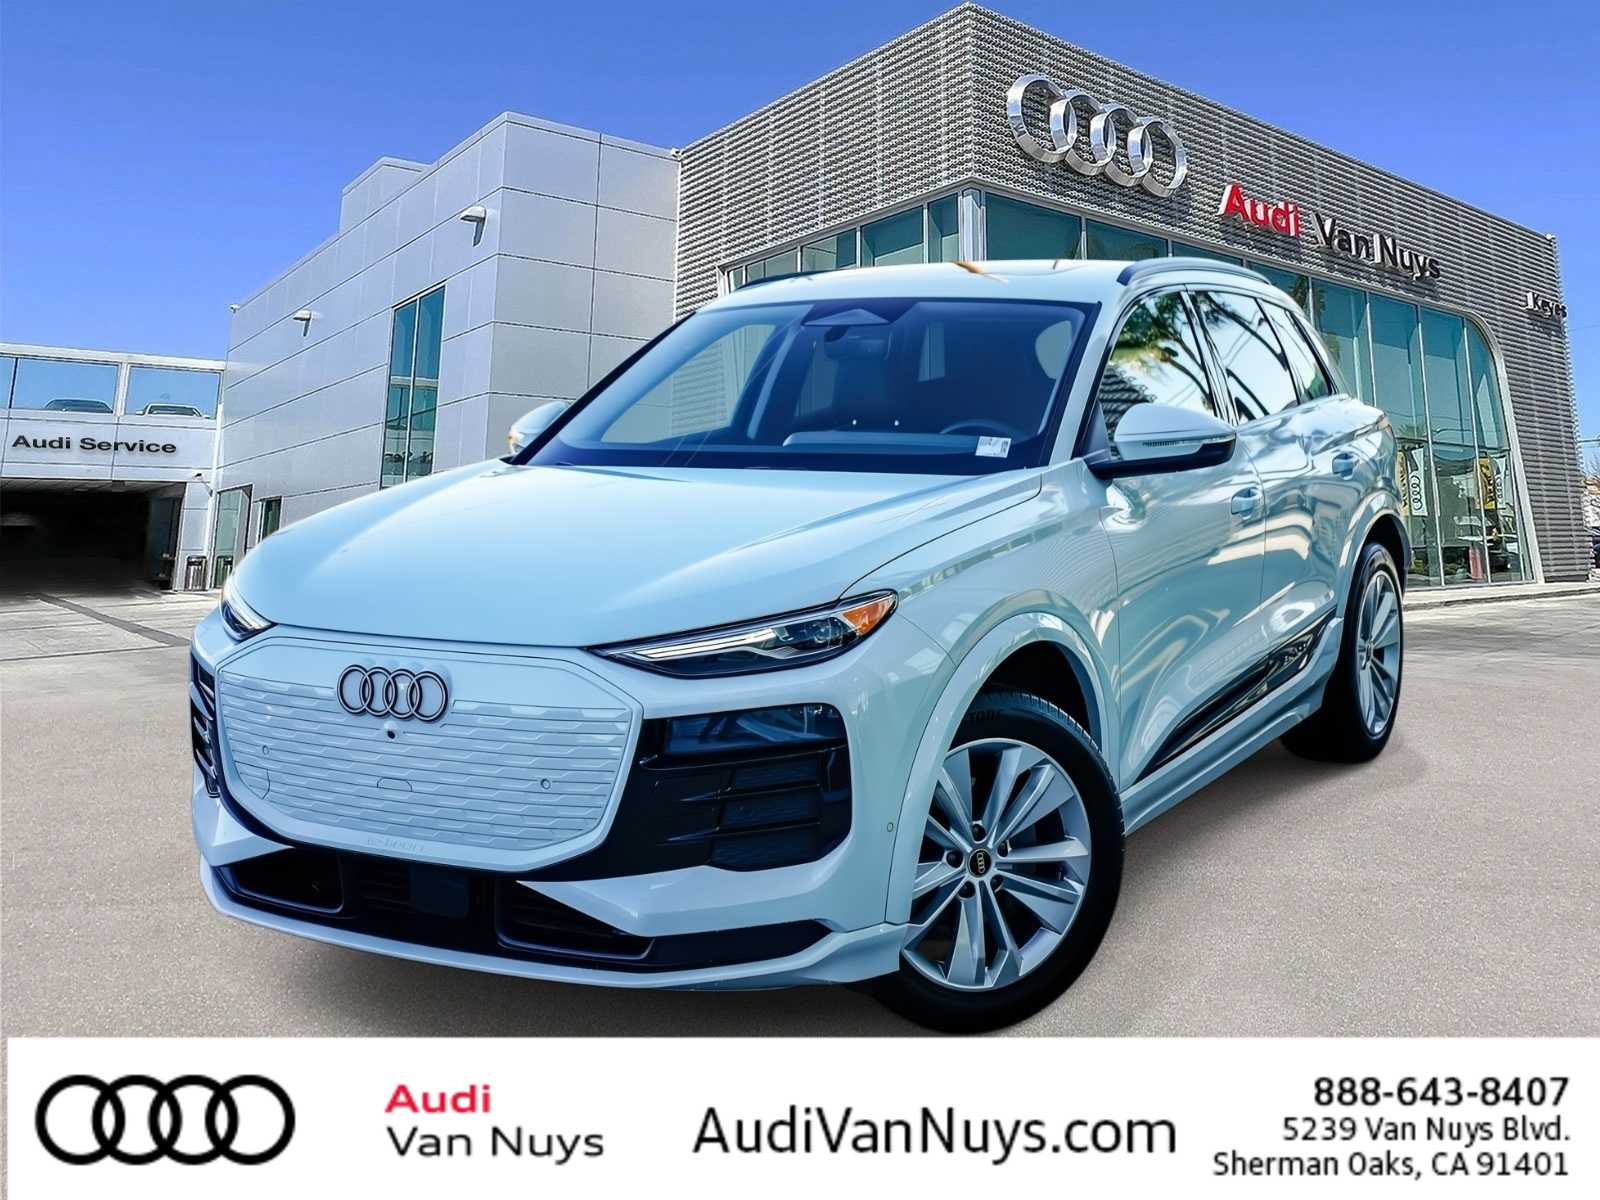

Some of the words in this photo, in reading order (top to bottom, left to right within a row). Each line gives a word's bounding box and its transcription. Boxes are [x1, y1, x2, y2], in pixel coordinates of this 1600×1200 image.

[1218, 182, 1302, 237] Audi
[1312, 211, 1371, 259] Van
[1373, 231, 1441, 281] Nuys
[12, 435, 72, 450] Audi
[79, 437, 177, 454] Service
